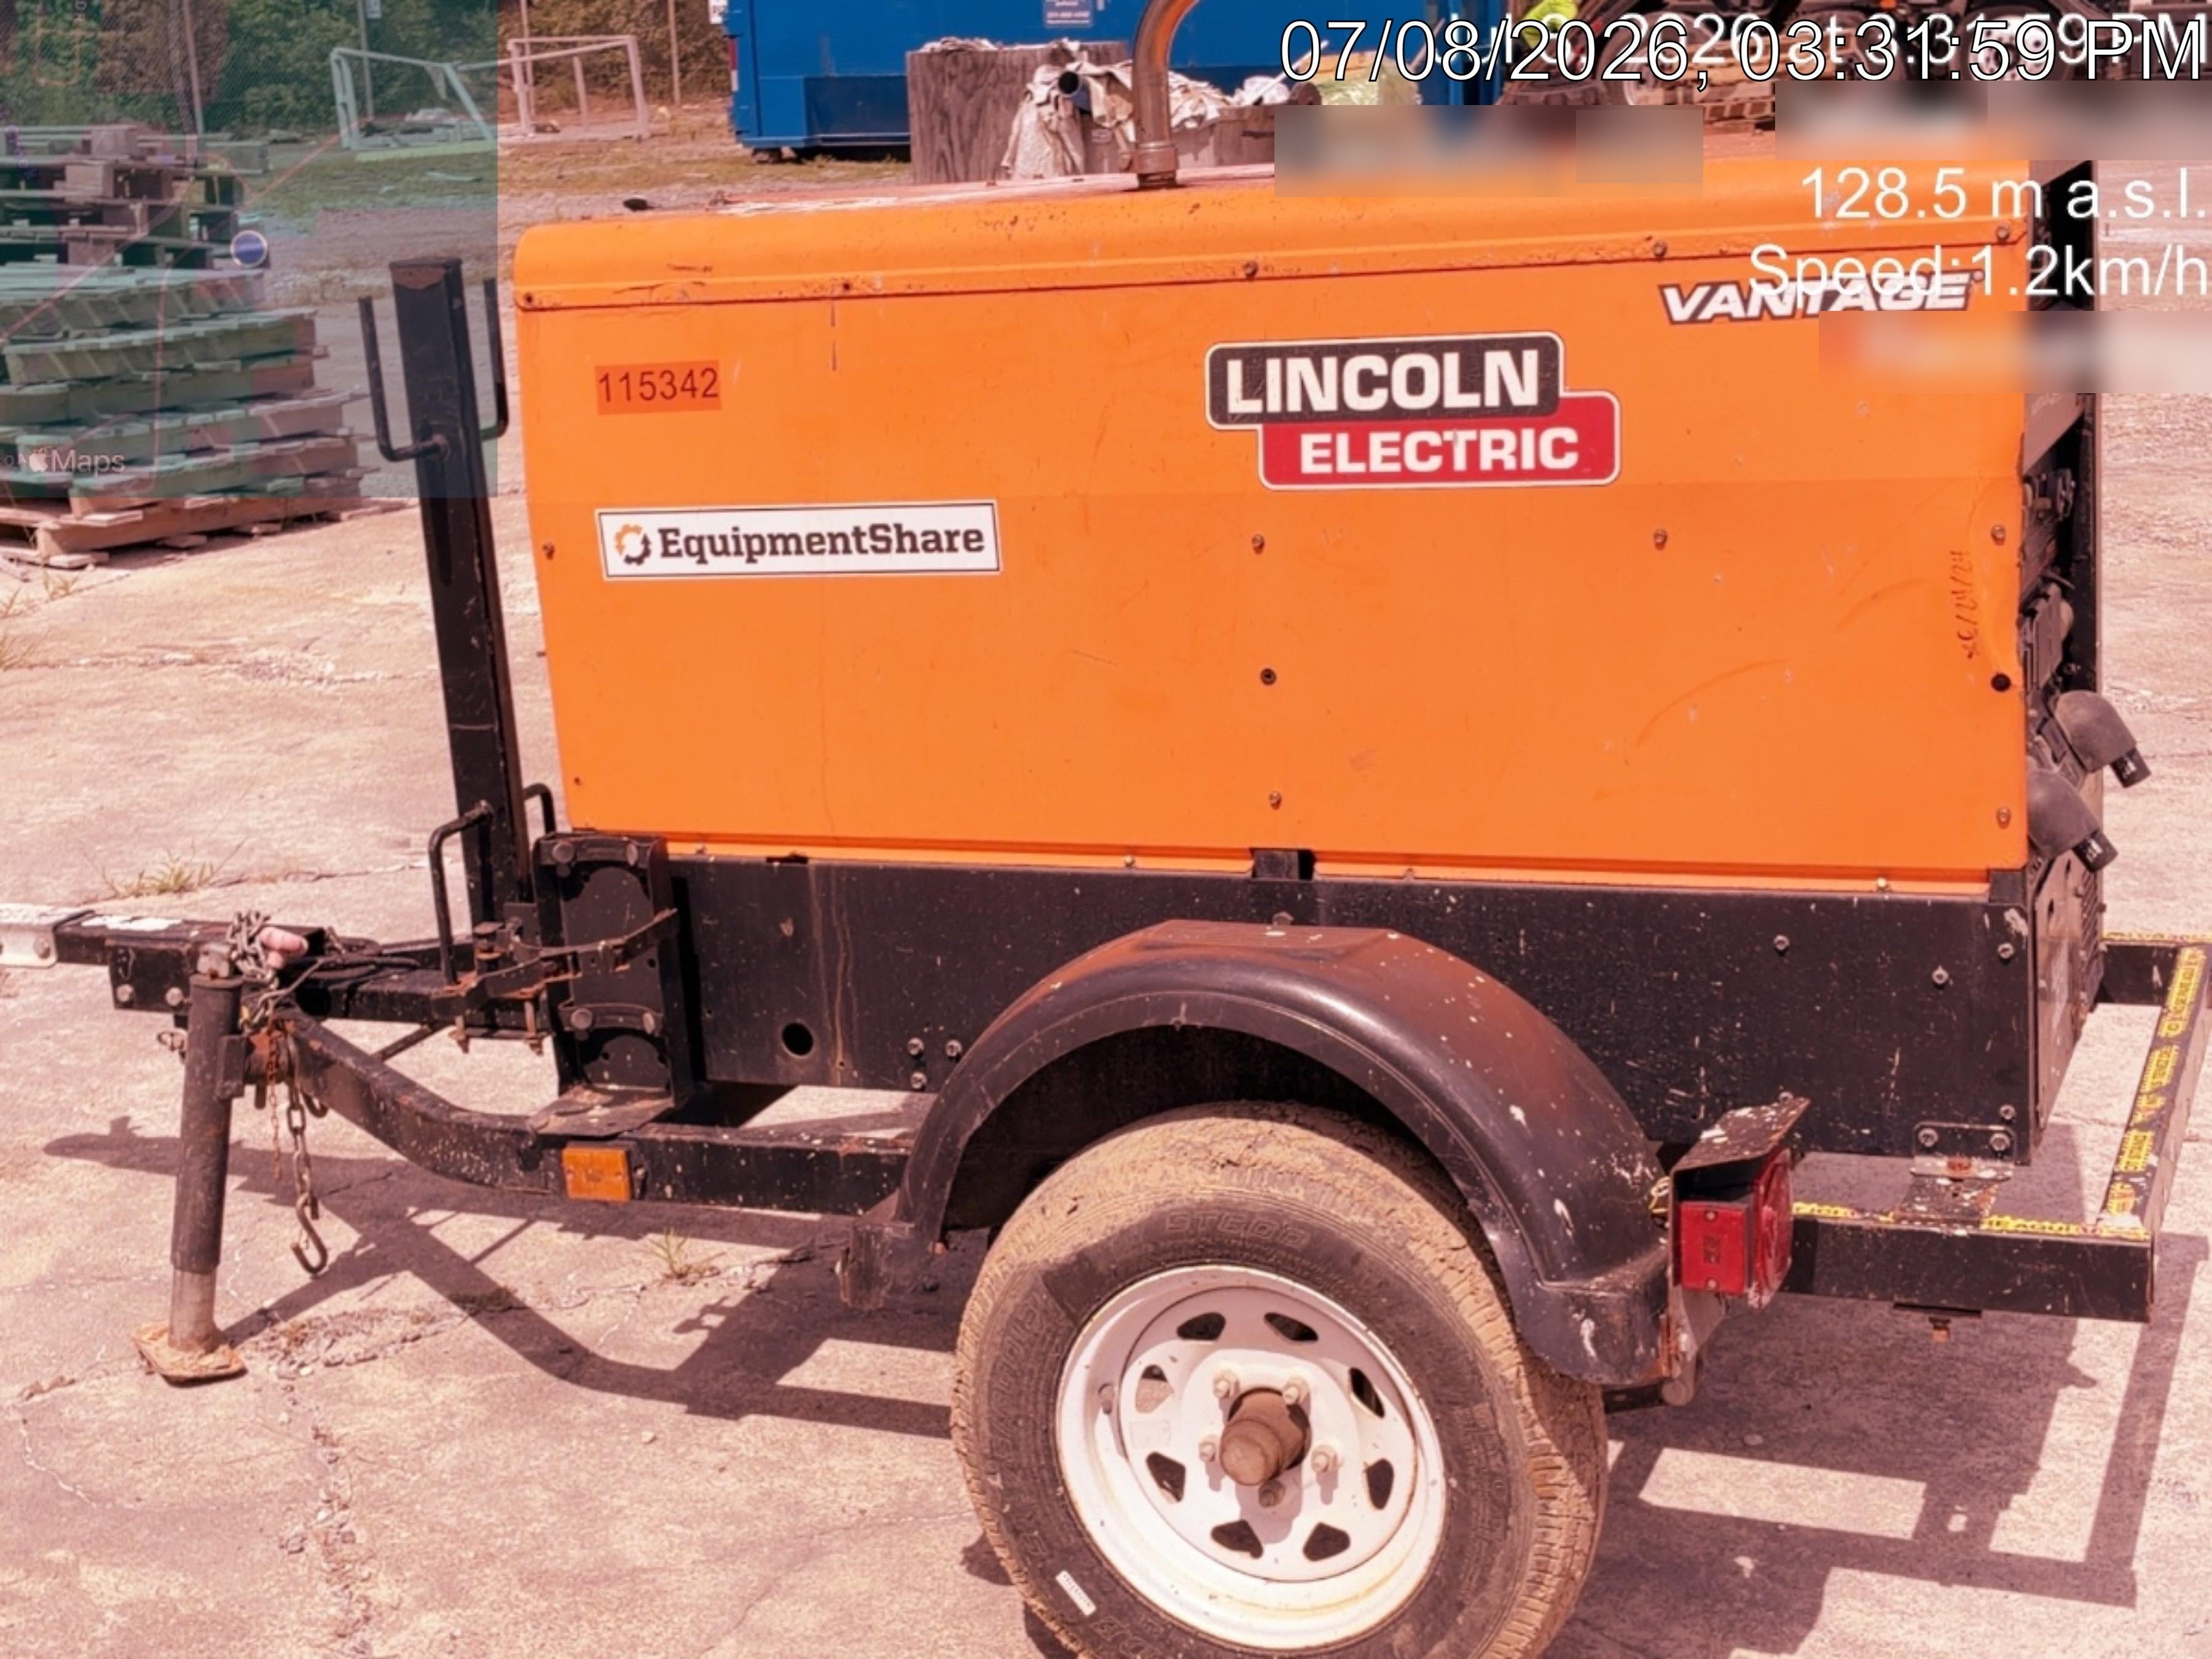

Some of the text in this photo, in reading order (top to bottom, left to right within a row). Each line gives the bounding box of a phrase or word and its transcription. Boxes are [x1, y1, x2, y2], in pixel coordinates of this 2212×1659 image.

[598, 367, 720, 403] 115342
[1227, 348, 1539, 415] LINCOLN
[1300, 426, 1579, 474] ELECTRIC
[657, 522, 985, 565] EquipmentShare
